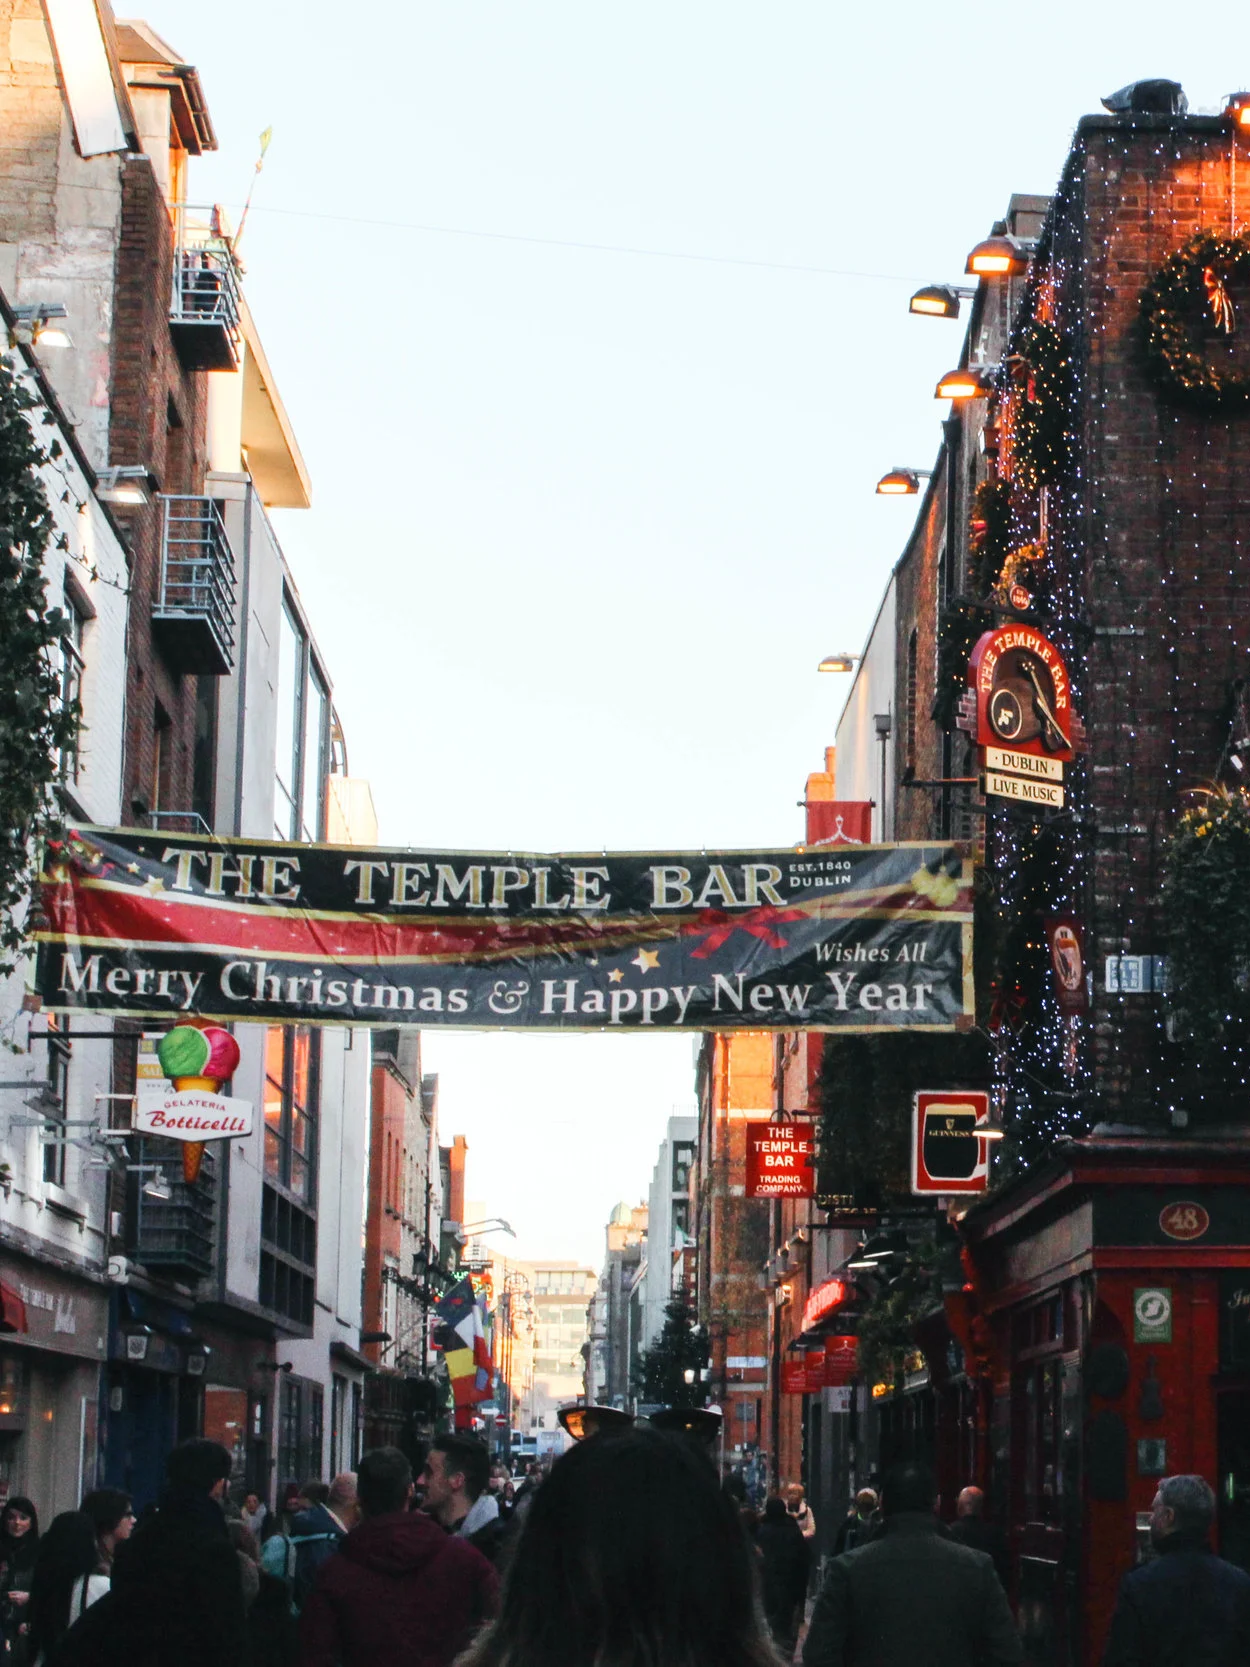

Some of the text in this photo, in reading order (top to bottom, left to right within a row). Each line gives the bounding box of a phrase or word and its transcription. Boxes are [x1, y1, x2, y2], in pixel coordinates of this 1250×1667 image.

[980, 631, 1067, 709] THE TEMPLE BAR
[1002, 754, 1049, 774] DUBLIN
[993, 778, 1058, 803] LIVE MUSIC
[162, 847, 788, 909] THE TEMPLE BAR
[789, 875, 852, 888] DUBLIN
[814, 942, 927, 963] Wishes All
[57, 952, 934, 1025] Merry Christmas & Happy New Year
[164, 1099, 226, 1111] GELATERIA
[146, 1110, 246, 1131] Botticelli
[768, 1127, 794, 1139] THE
[754, 1141, 808, 1153] TEMPLE
[765, 1155, 794, 1167] BAR
[756, 1185, 803, 1193] COMPANY
[760, 1175, 801, 1183] TRADING
[1168, 1207, 1198, 1231] 48
